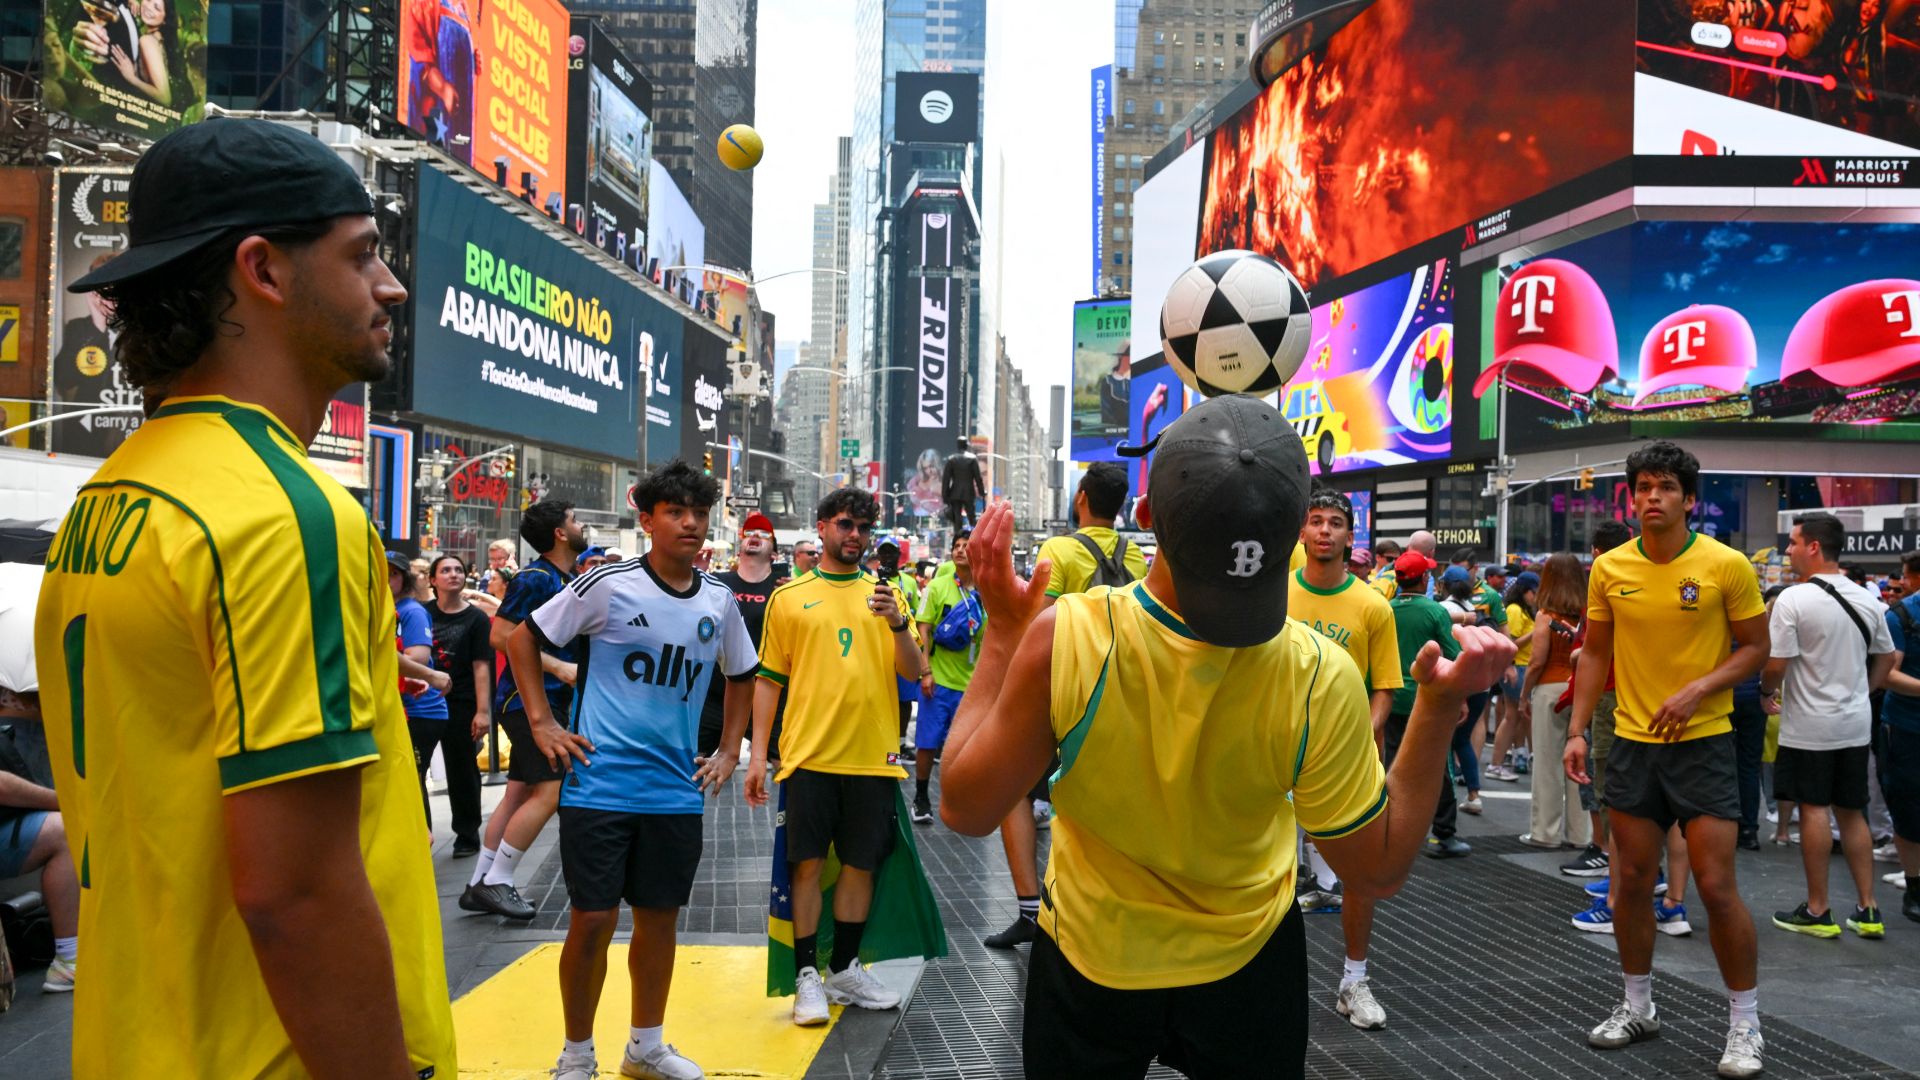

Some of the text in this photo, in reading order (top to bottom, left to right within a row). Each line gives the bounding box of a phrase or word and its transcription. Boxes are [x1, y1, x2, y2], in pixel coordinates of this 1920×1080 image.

[492, 13, 550, 92] VISTA
[1742, 35, 1777, 49] Subscribe
[568, 58, 584, 70] LG
[490, 56, 550, 126] SOCIAL
[489, 96, 549, 165] CLUB
[1835, 159, 1910, 171] MARRIOTT
[1835, 172, 1901, 184] MARQUIS
[102, 178, 111, 193] 8
[1479, 209, 1511, 230] MARRIOTT
[1479, 222, 1507, 240] MARQUIS
[465, 241, 612, 345] BRASILEIRO NÃO
[1511, 275, 1555, 335] T
[440, 286, 623, 391] ABANDONA NUNCA.
[1664, 320, 1706, 364] T
[921, 295, 946, 426] FRIDAY
[695, 374, 723, 411] alexa+
[95, 416, 128, 431] carry
[1448, 463, 1475, 474] SEPHORA
[1227, 540, 1265, 578] B
[1841, 534, 1904, 552] RICAN
[838, 628, 853, 658] 9
[623, 643, 703, 702] ally
